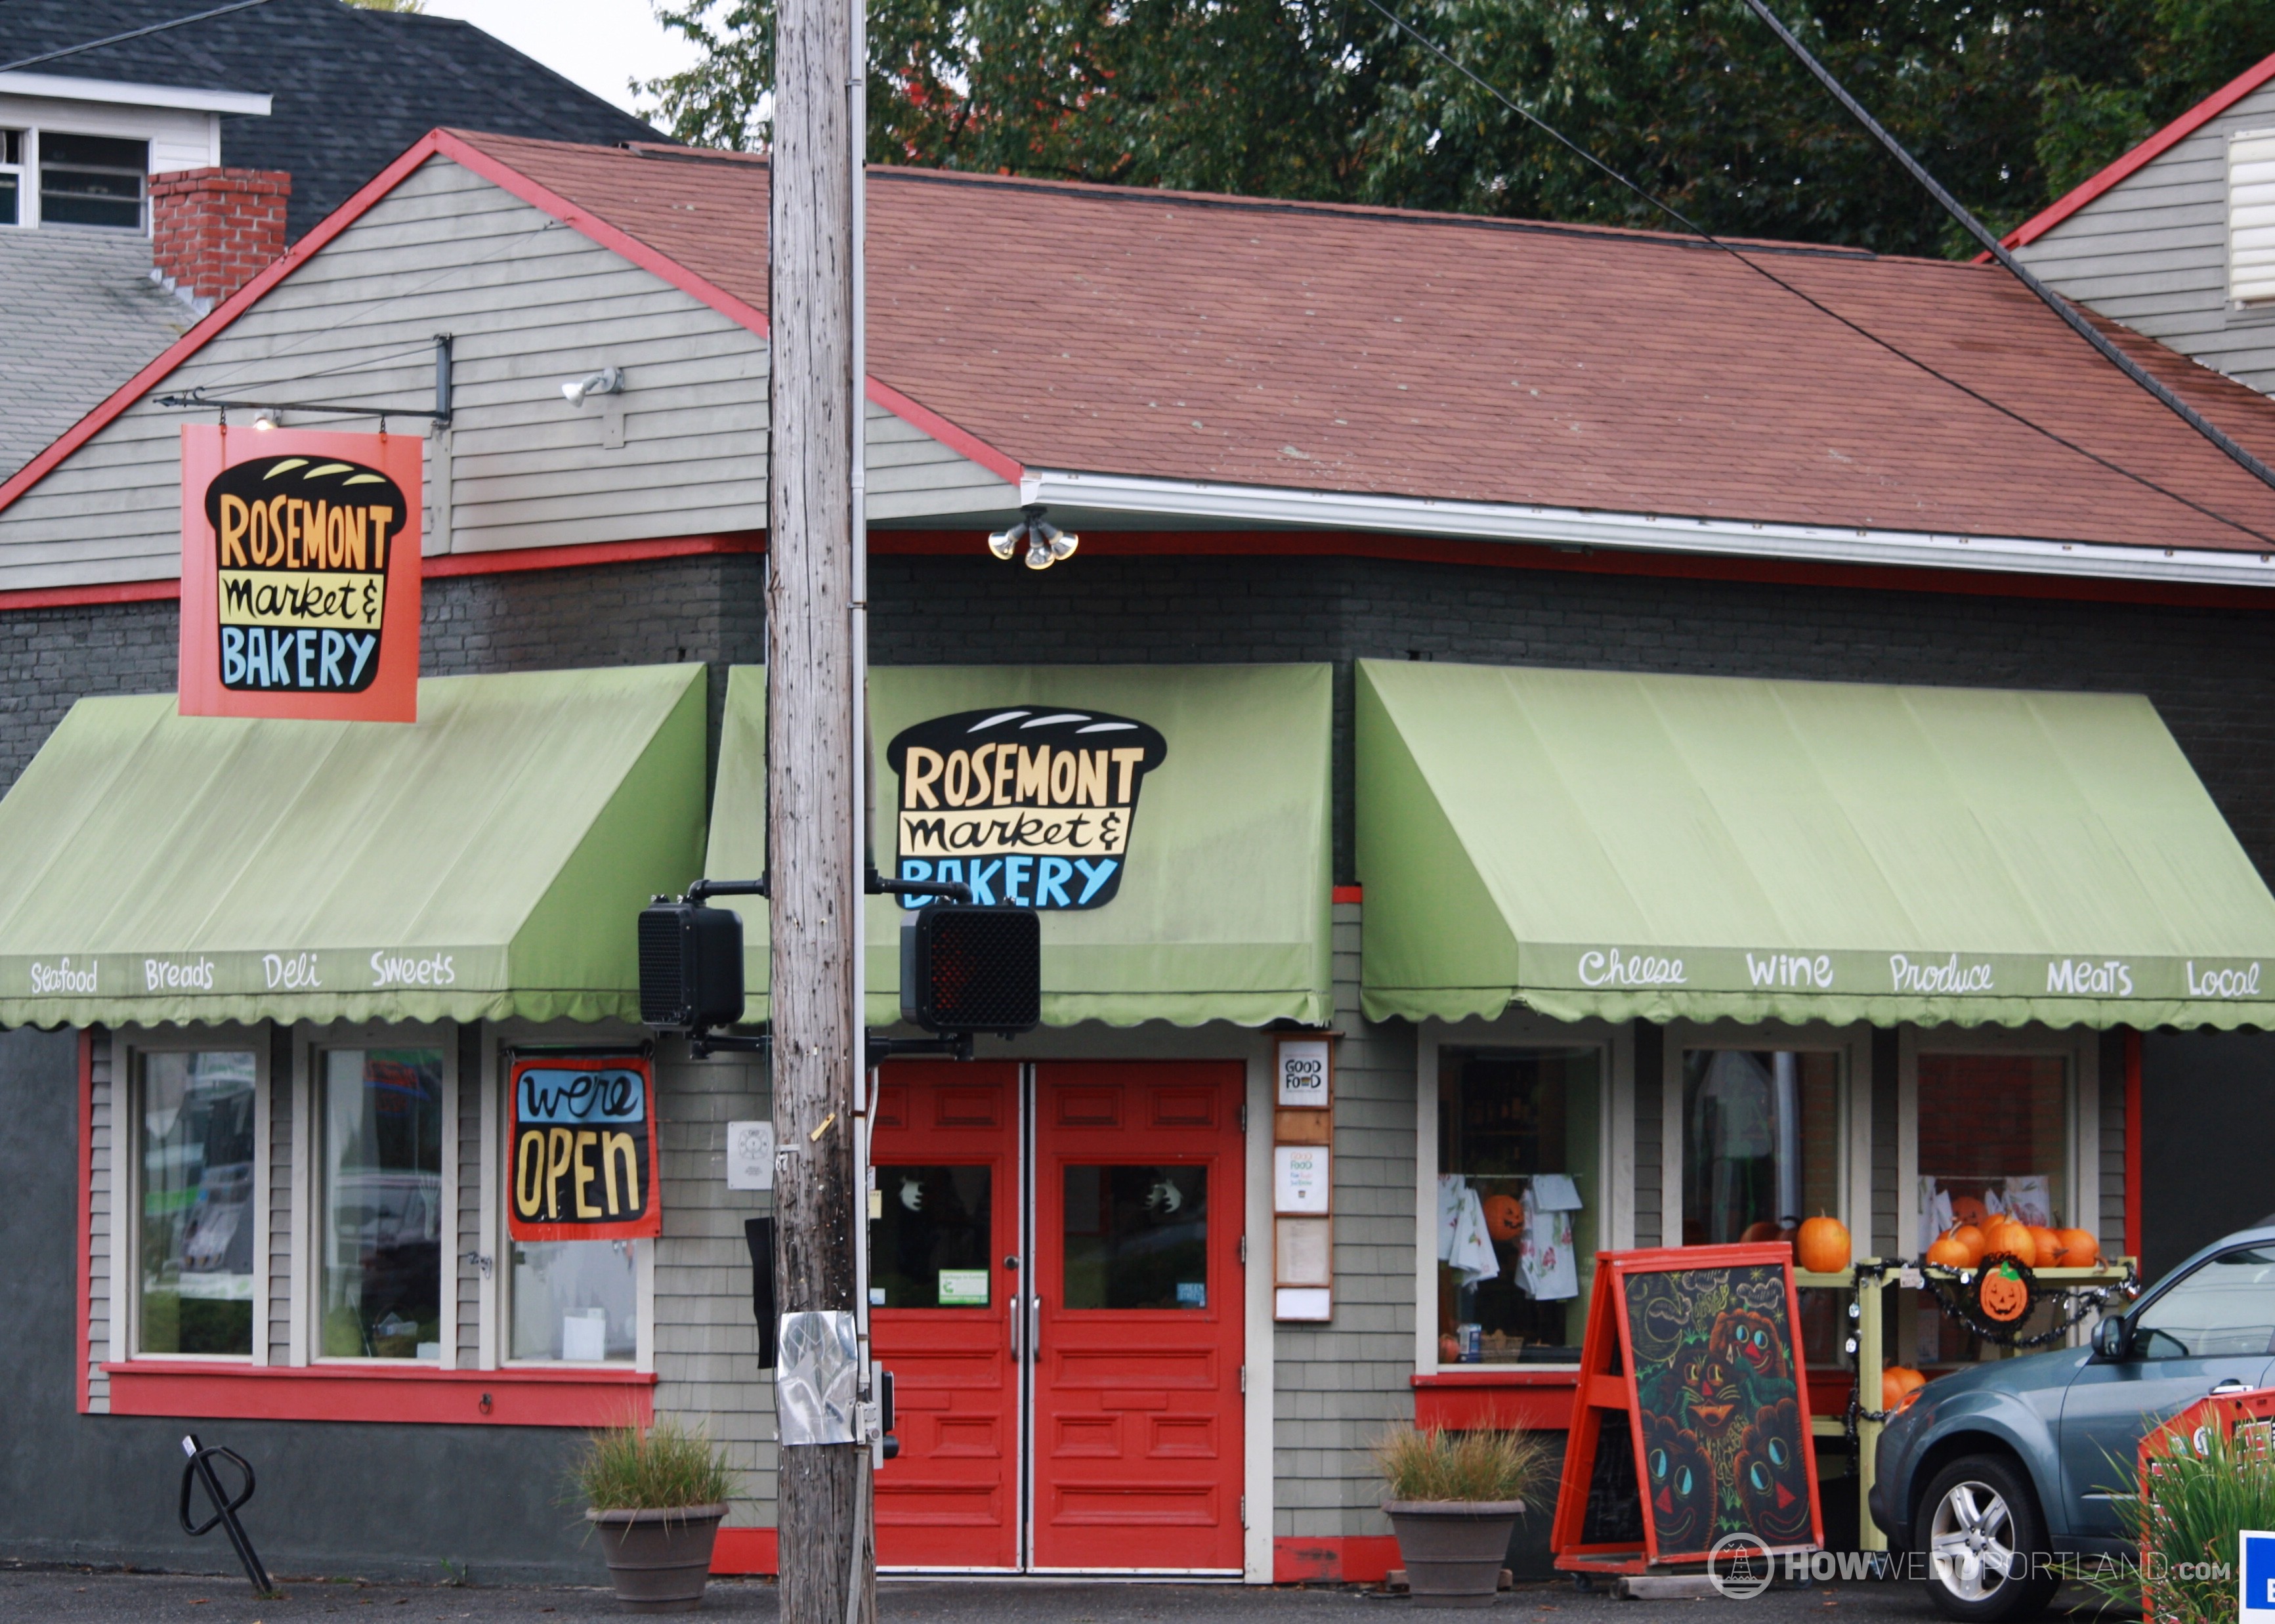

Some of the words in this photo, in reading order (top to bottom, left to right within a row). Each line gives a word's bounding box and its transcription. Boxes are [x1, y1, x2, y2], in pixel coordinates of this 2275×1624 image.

[220, 494, 393, 570] ROSEMONT
[362, 579, 377, 623] &
[223, 628, 376, 687] BAKERY
[904, 742, 1144, 809] ROSEMONT
[1099, 812, 1121, 851] &
[903, 856, 1118, 908] BAKERY
[30, 958, 98, 993] Seafood
[144, 956, 215, 991] Breads
[263, 952, 323, 989] Deli
[370, 951, 455, 986] Sweets
[1578, 948, 1688, 987] Cheese
[1745, 952, 1833, 988] Wine
[1890, 953, 1994, 993] Produce
[2186, 960, 2261, 997] Local
[1285, 1059, 1321, 1073] GOOD
